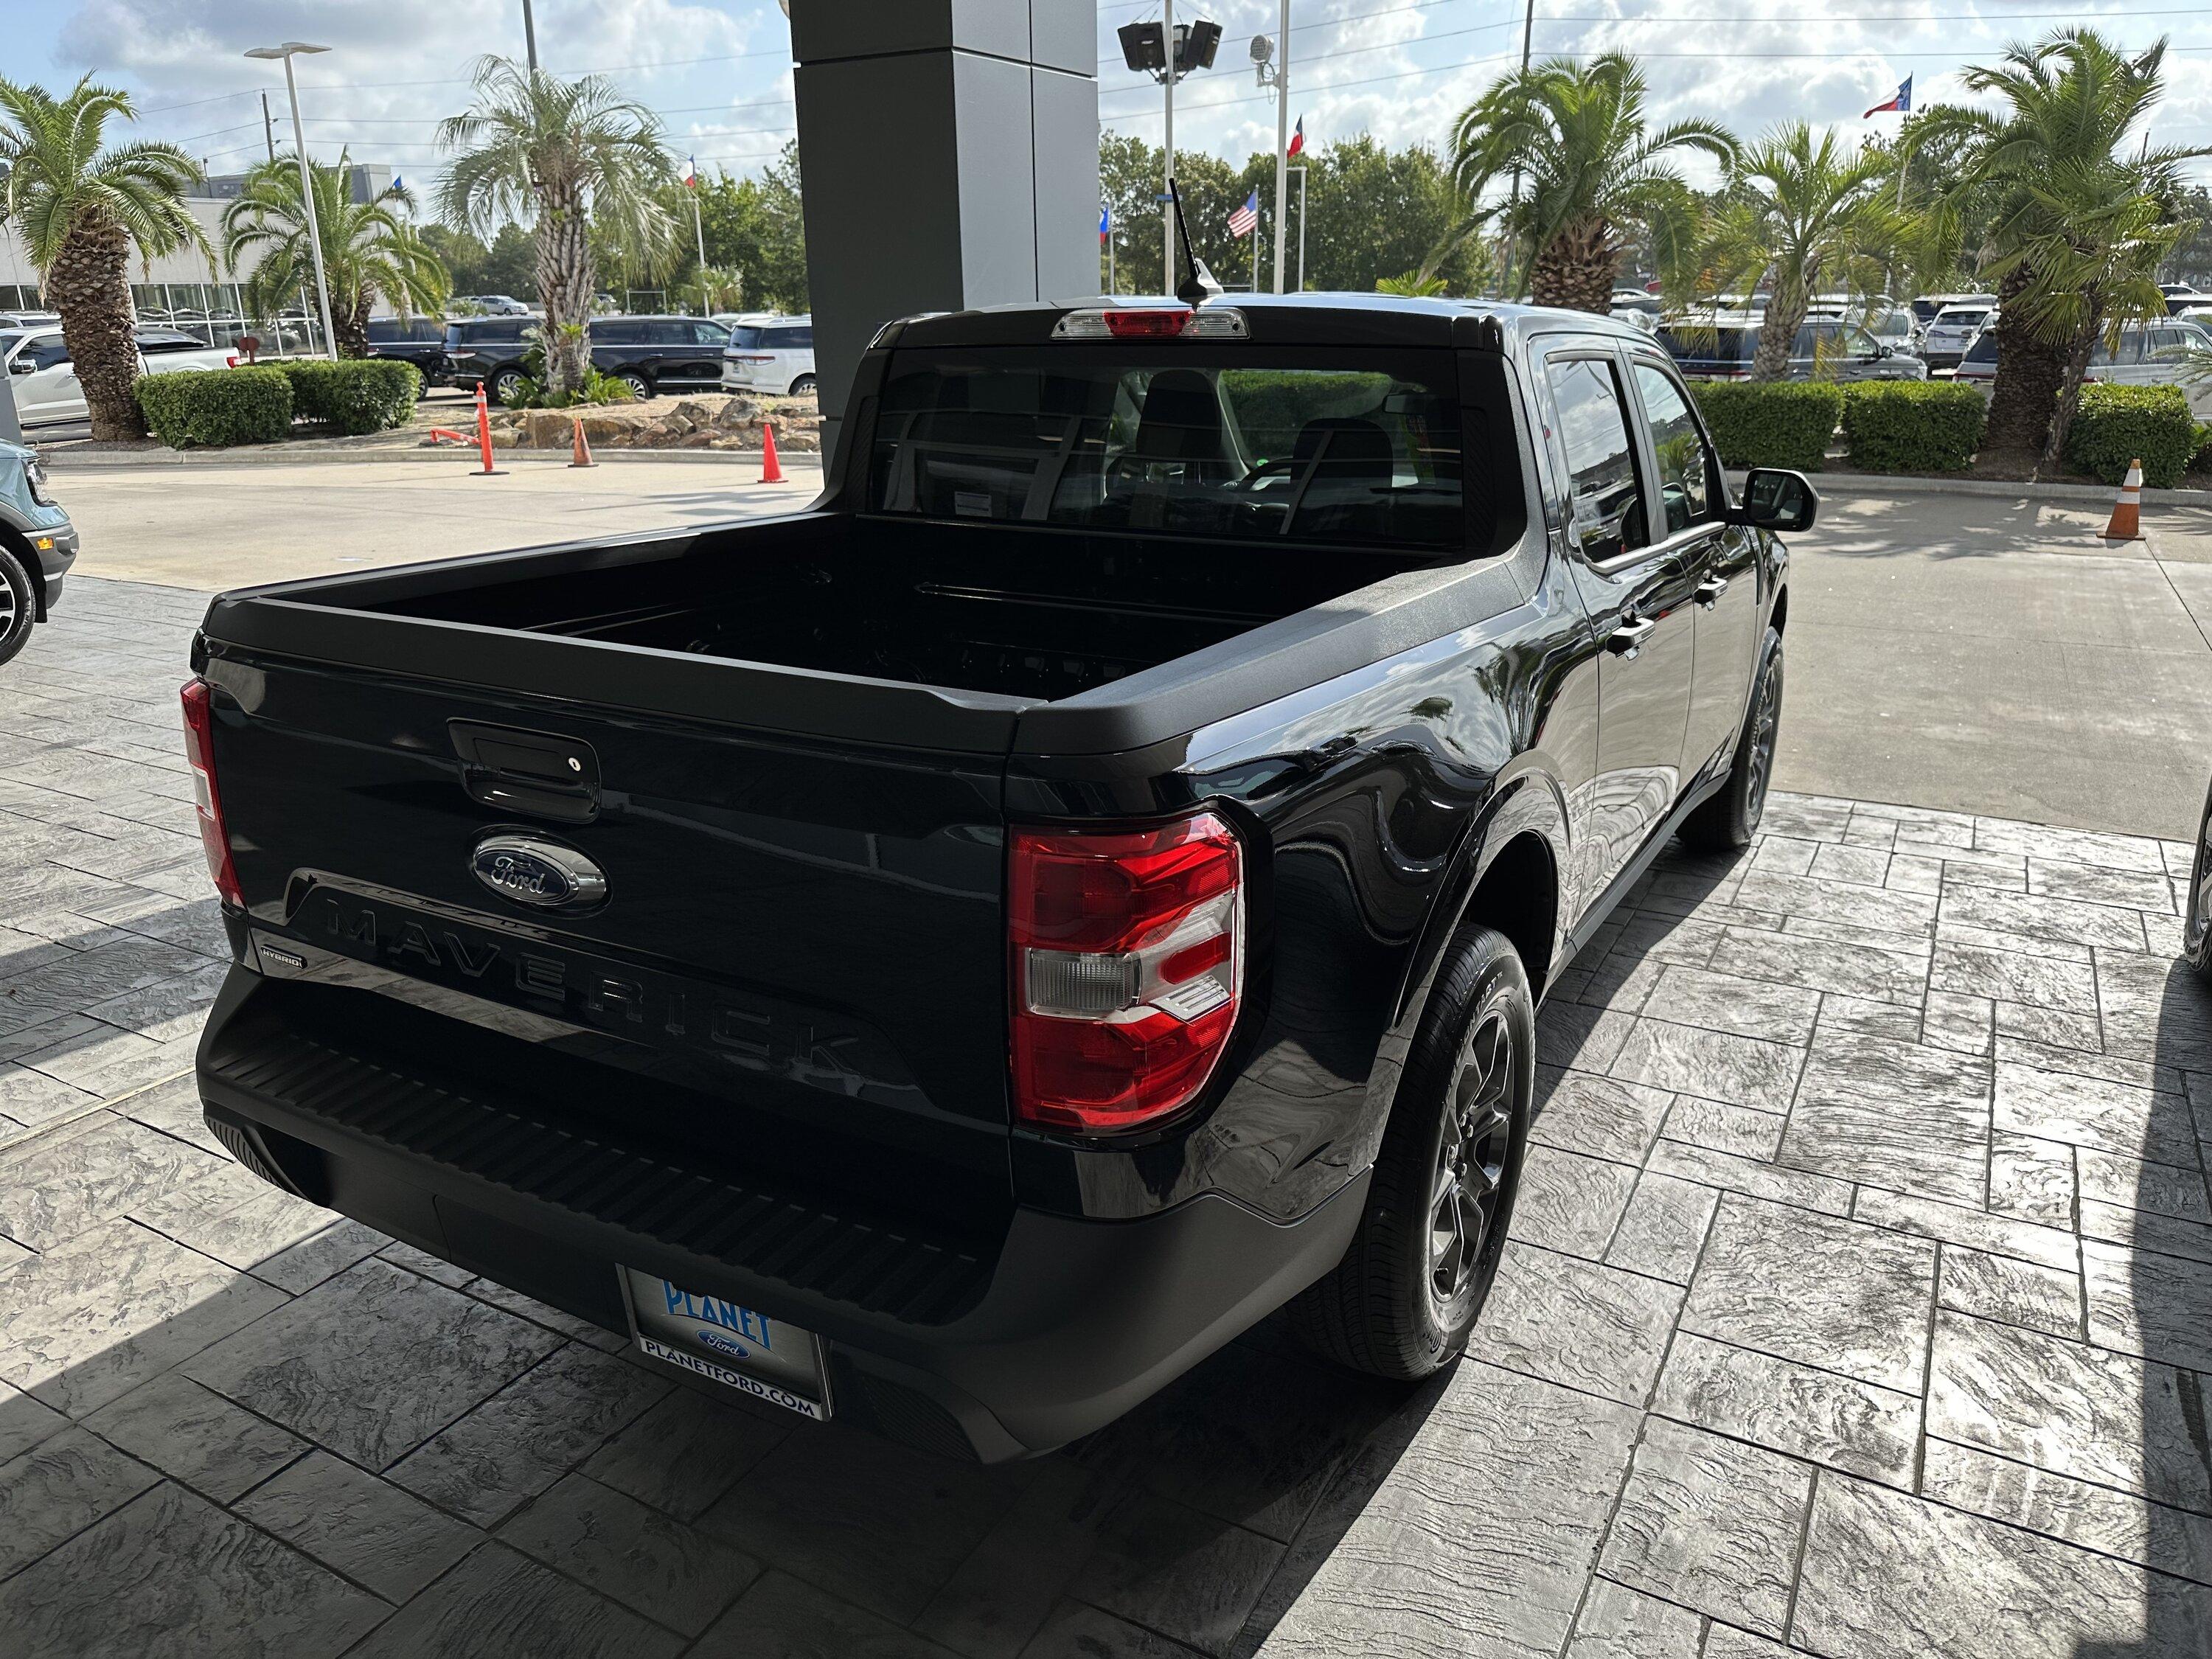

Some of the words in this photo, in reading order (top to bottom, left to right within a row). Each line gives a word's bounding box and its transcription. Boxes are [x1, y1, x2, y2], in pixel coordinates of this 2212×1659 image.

[491, 856, 546, 894] Ford
[262, 948, 299, 967] HYBRID
[326, 898, 863, 1079] MAVERICK
[664, 1279, 771, 1350] PLANET
[707, 1333, 740, 1356] Ford
[646, 1340, 815, 1416] PLANETFORD.COM
